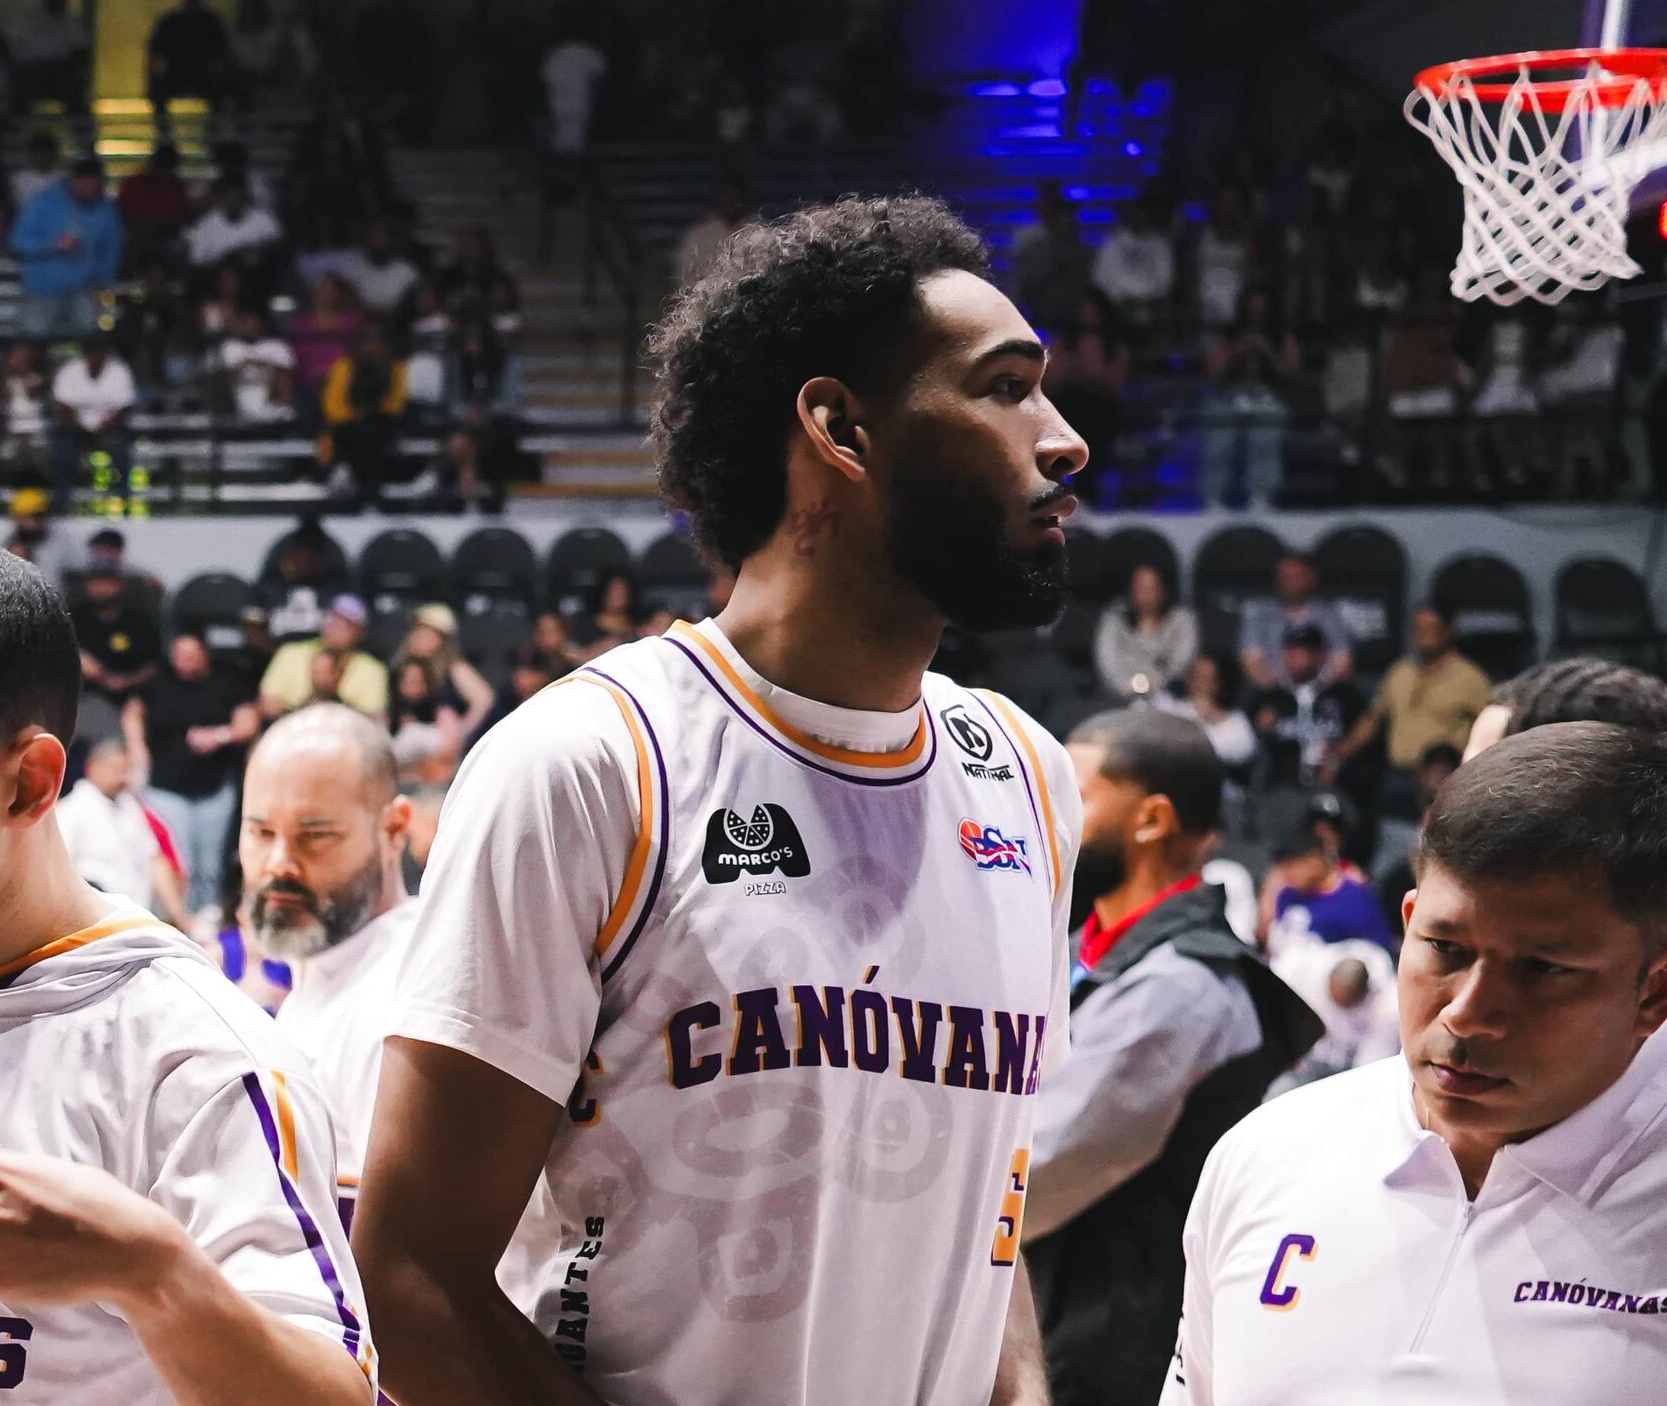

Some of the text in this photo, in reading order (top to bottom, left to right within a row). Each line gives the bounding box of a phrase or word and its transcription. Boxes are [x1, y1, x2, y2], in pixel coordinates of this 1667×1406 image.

[717, 846, 794, 866] MARCO'S
[744, 880, 787, 897] PIZZA
[1260, 1233, 1319, 1312] C
